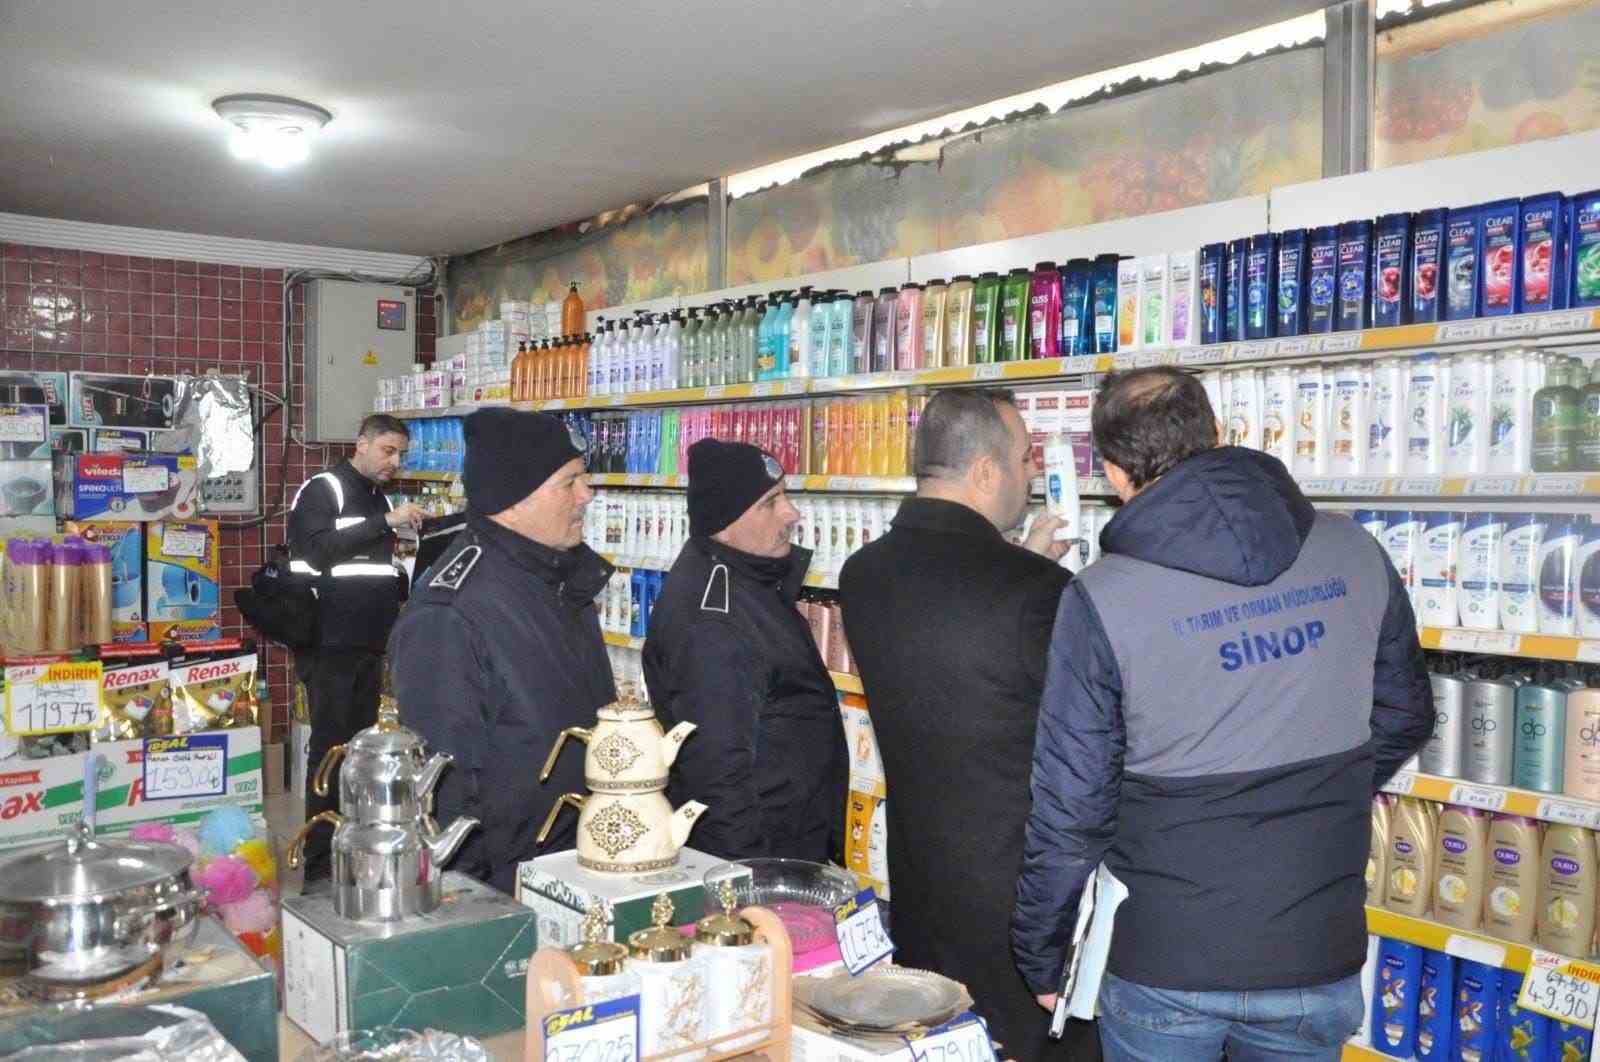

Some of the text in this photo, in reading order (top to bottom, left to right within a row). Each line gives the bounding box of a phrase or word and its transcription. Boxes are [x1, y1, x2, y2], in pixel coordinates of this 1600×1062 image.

[1486, 216, 1513, 228] CLEAR
[1414, 234, 1439, 245] CLEAR
[1225, 605, 1241, 624] VE
[1219, 620, 1326, 672] SİNOP
[103, 667, 161, 689] Renax
[187, 660, 241, 683] Renax
[1471, 713, 1497, 737] dp
[1521, 718, 1546, 740] dp
